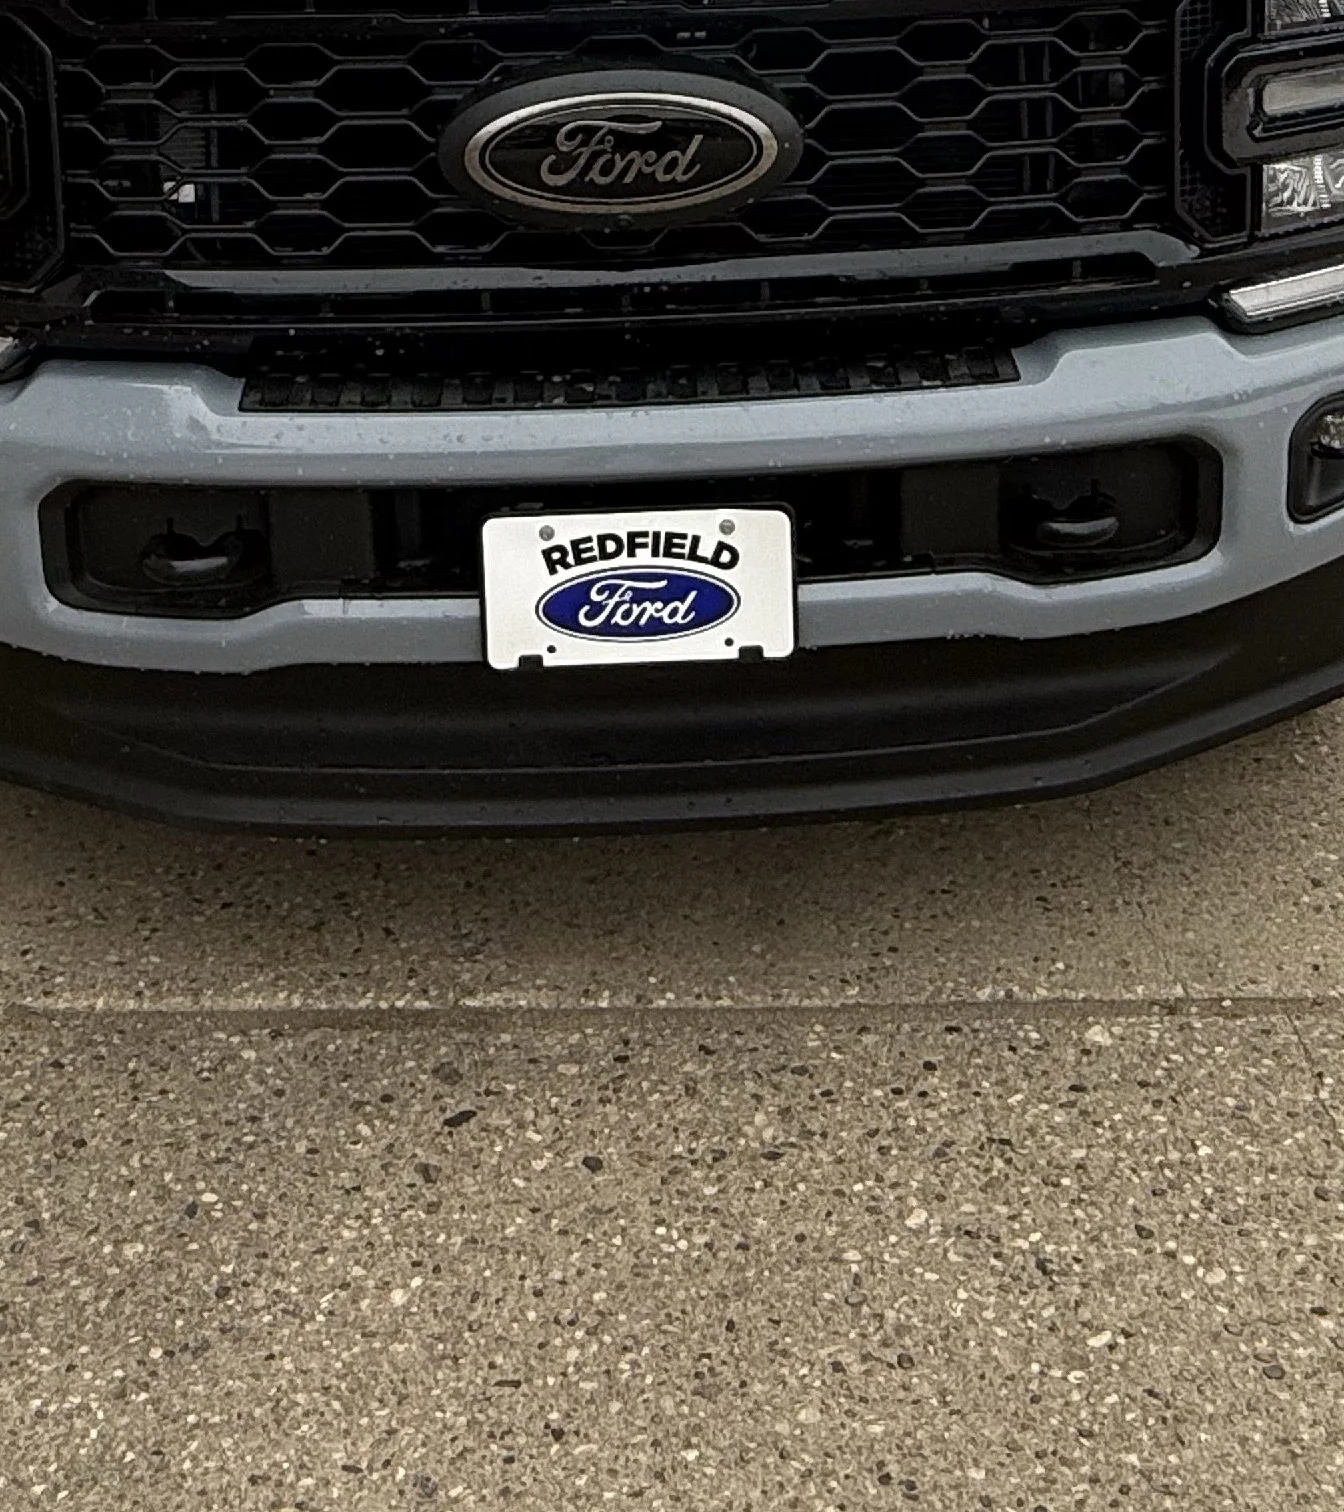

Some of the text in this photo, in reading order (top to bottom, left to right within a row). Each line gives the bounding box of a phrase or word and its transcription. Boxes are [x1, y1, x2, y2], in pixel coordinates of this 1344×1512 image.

[540, 120, 704, 187] Ford
[541, 530, 740, 576] REDFIELD
[578, 578, 698, 627] Ford
